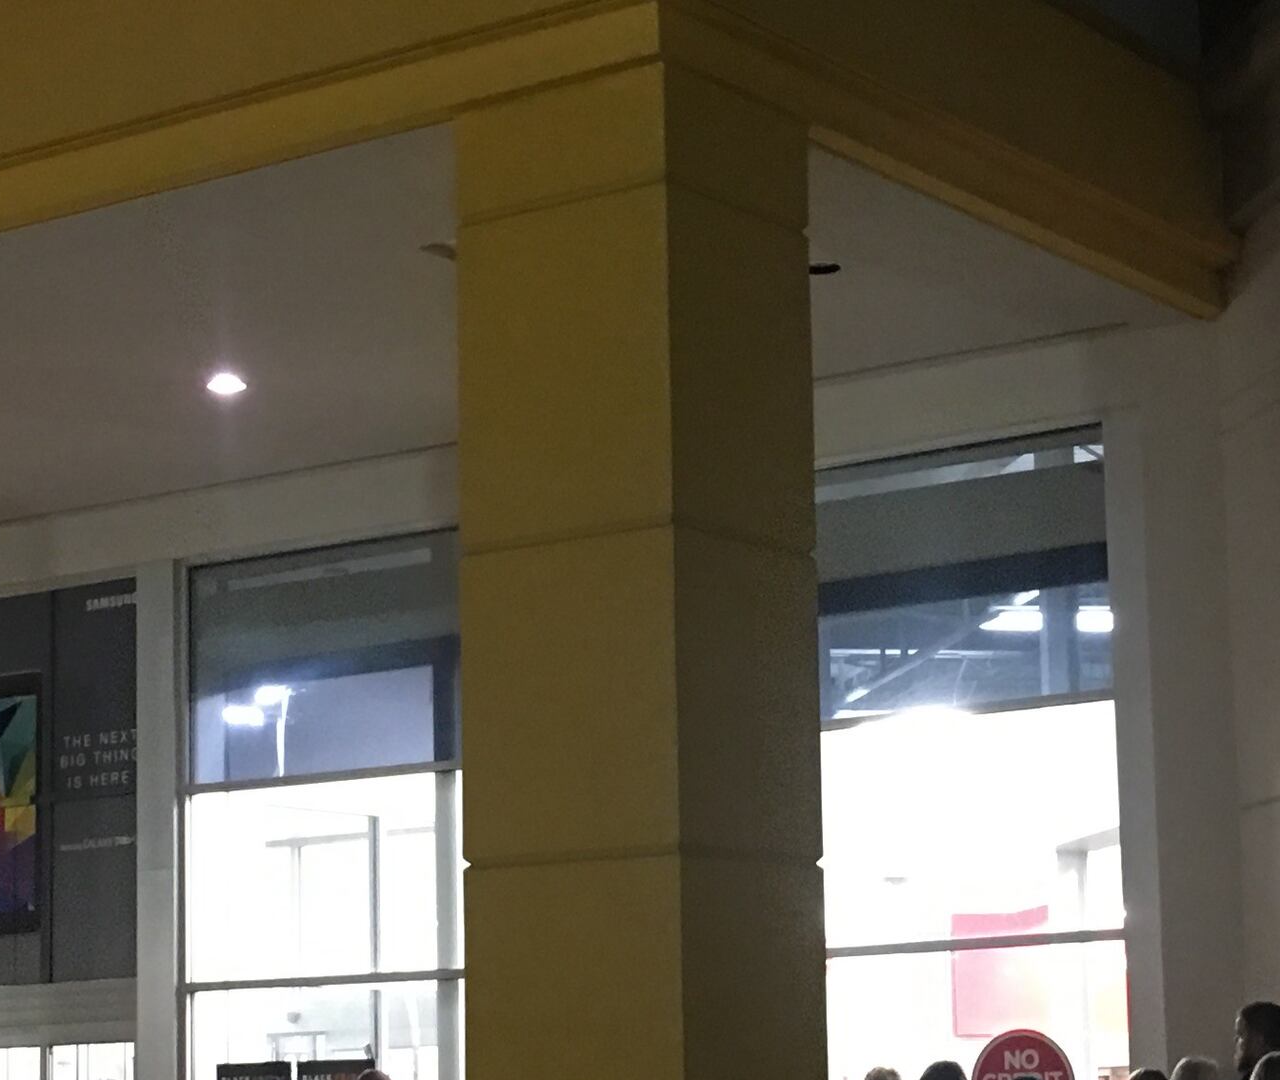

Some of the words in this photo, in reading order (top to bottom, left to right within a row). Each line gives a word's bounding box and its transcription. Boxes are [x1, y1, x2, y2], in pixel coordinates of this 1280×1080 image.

[63, 734, 91, 749] THE
[99, 728, 136, 745] NEXT
[60, 752, 86, 769] BIG
[66, 775, 82, 789] IS
[89, 770, 129, 787] HERE
[1004, 1048, 1040, 1070] NO
